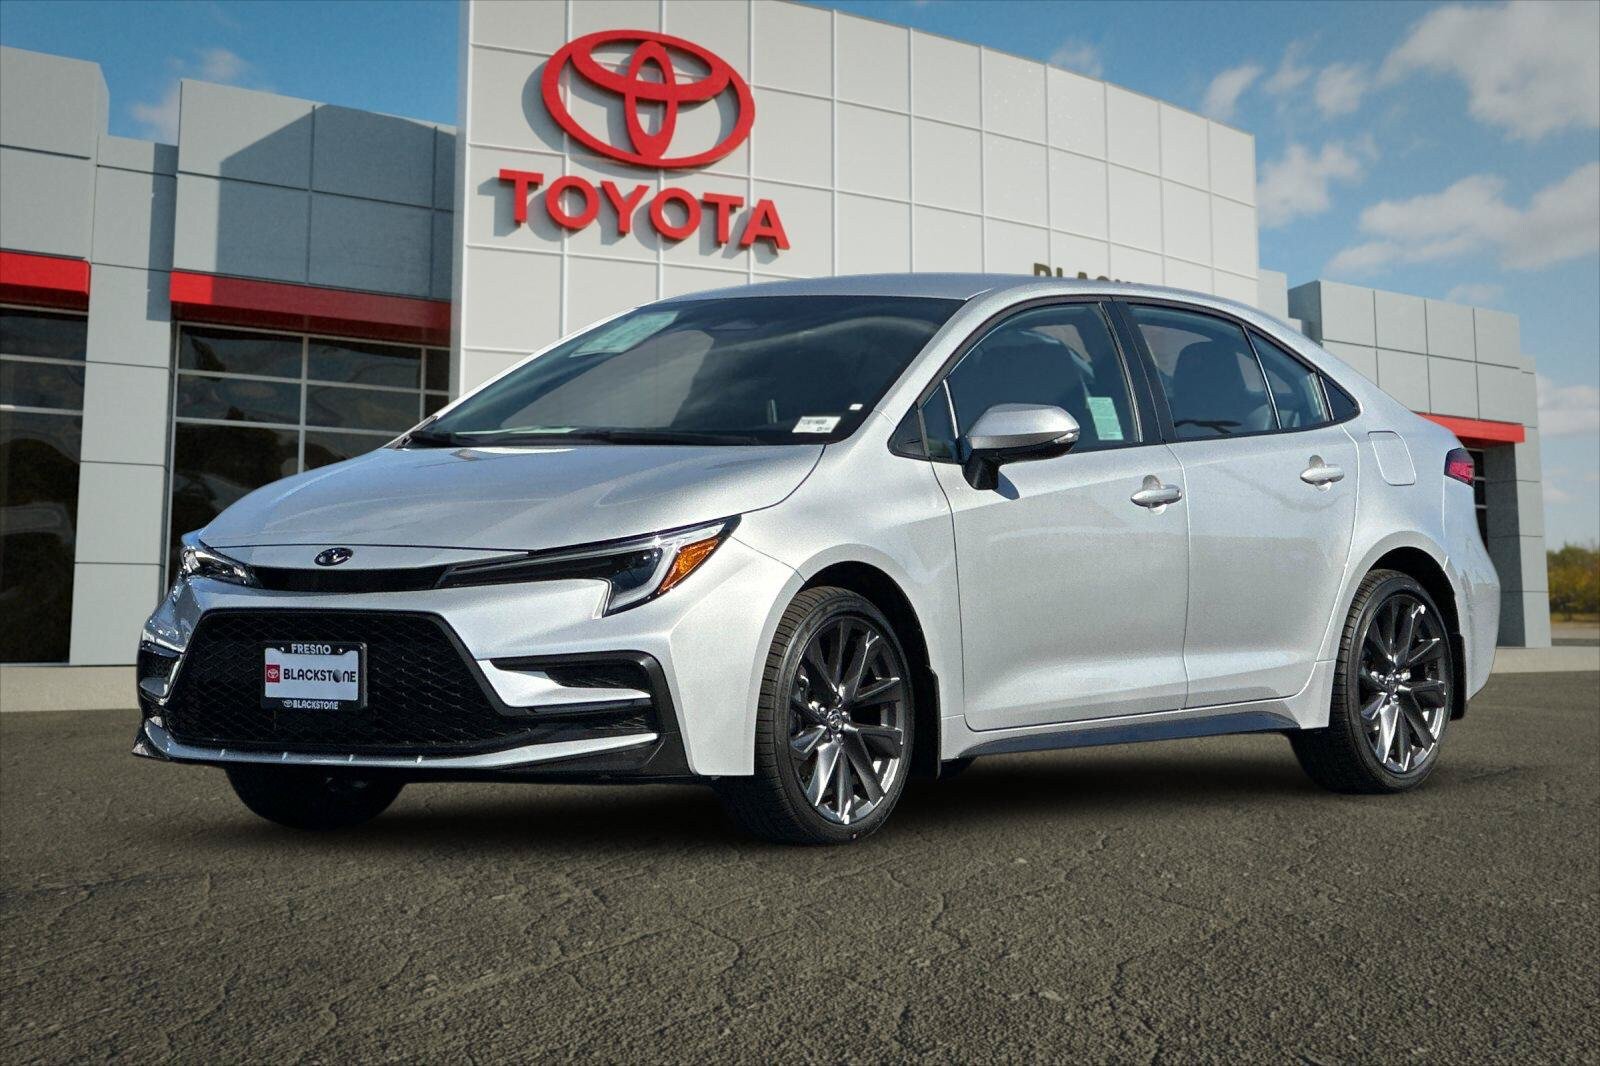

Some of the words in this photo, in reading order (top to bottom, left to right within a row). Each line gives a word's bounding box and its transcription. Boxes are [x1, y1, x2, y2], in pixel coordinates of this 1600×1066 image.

[498, 168, 791, 251] TOYOTA
[291, 643, 332, 655] FRESNO
[283, 668, 357, 683] BLACKSTONE
[292, 700, 339, 710] BLACKSTONE
